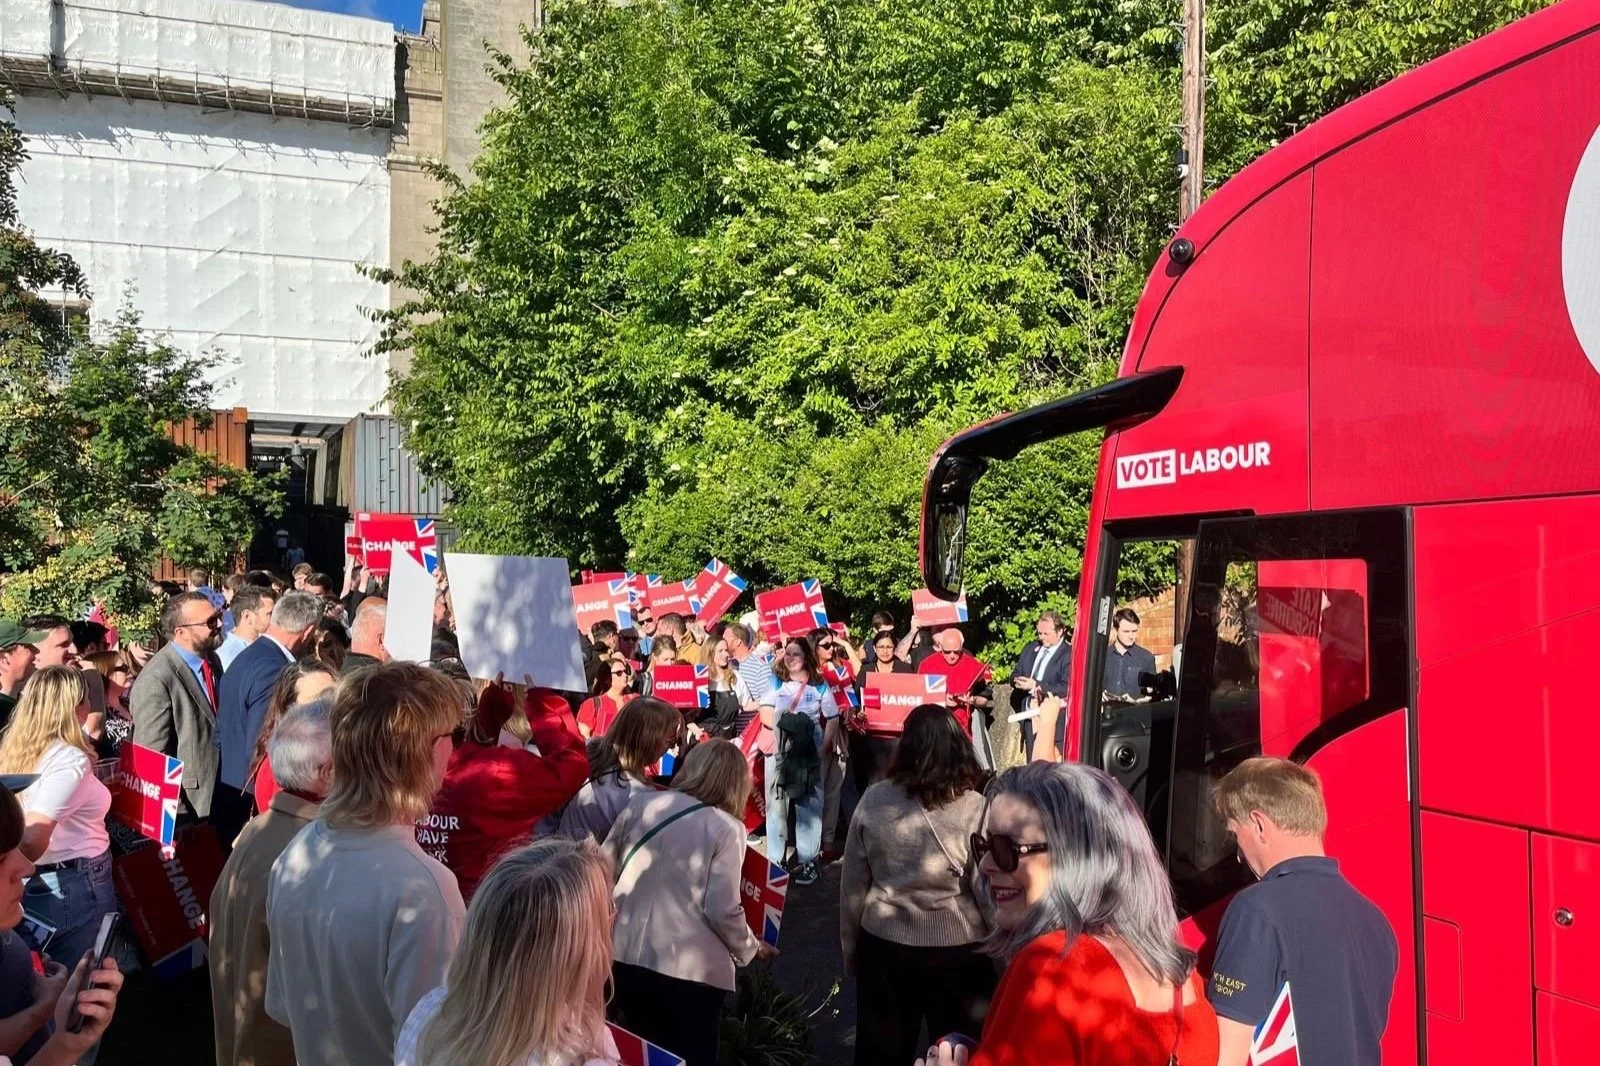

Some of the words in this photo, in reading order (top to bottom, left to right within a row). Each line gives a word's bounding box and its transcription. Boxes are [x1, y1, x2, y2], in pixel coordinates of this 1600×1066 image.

[1121, 456, 1171, 482] VOTE
[1180, 441, 1271, 475] LABOUR
[652, 594, 685, 607] CHANGE
[700, 581, 722, 608] ANGE
[576, 600, 609, 613] ANGE
[778, 602, 806, 617] ANGE
[655, 681, 694, 690] CHANGE
[880, 694, 924, 706] HANGE
[119, 772, 161, 801] CHANGE
[417, 829, 448, 844] HAVE
[162, 857, 208, 930] HANGE
[1226, 978, 1247, 991] EAST
